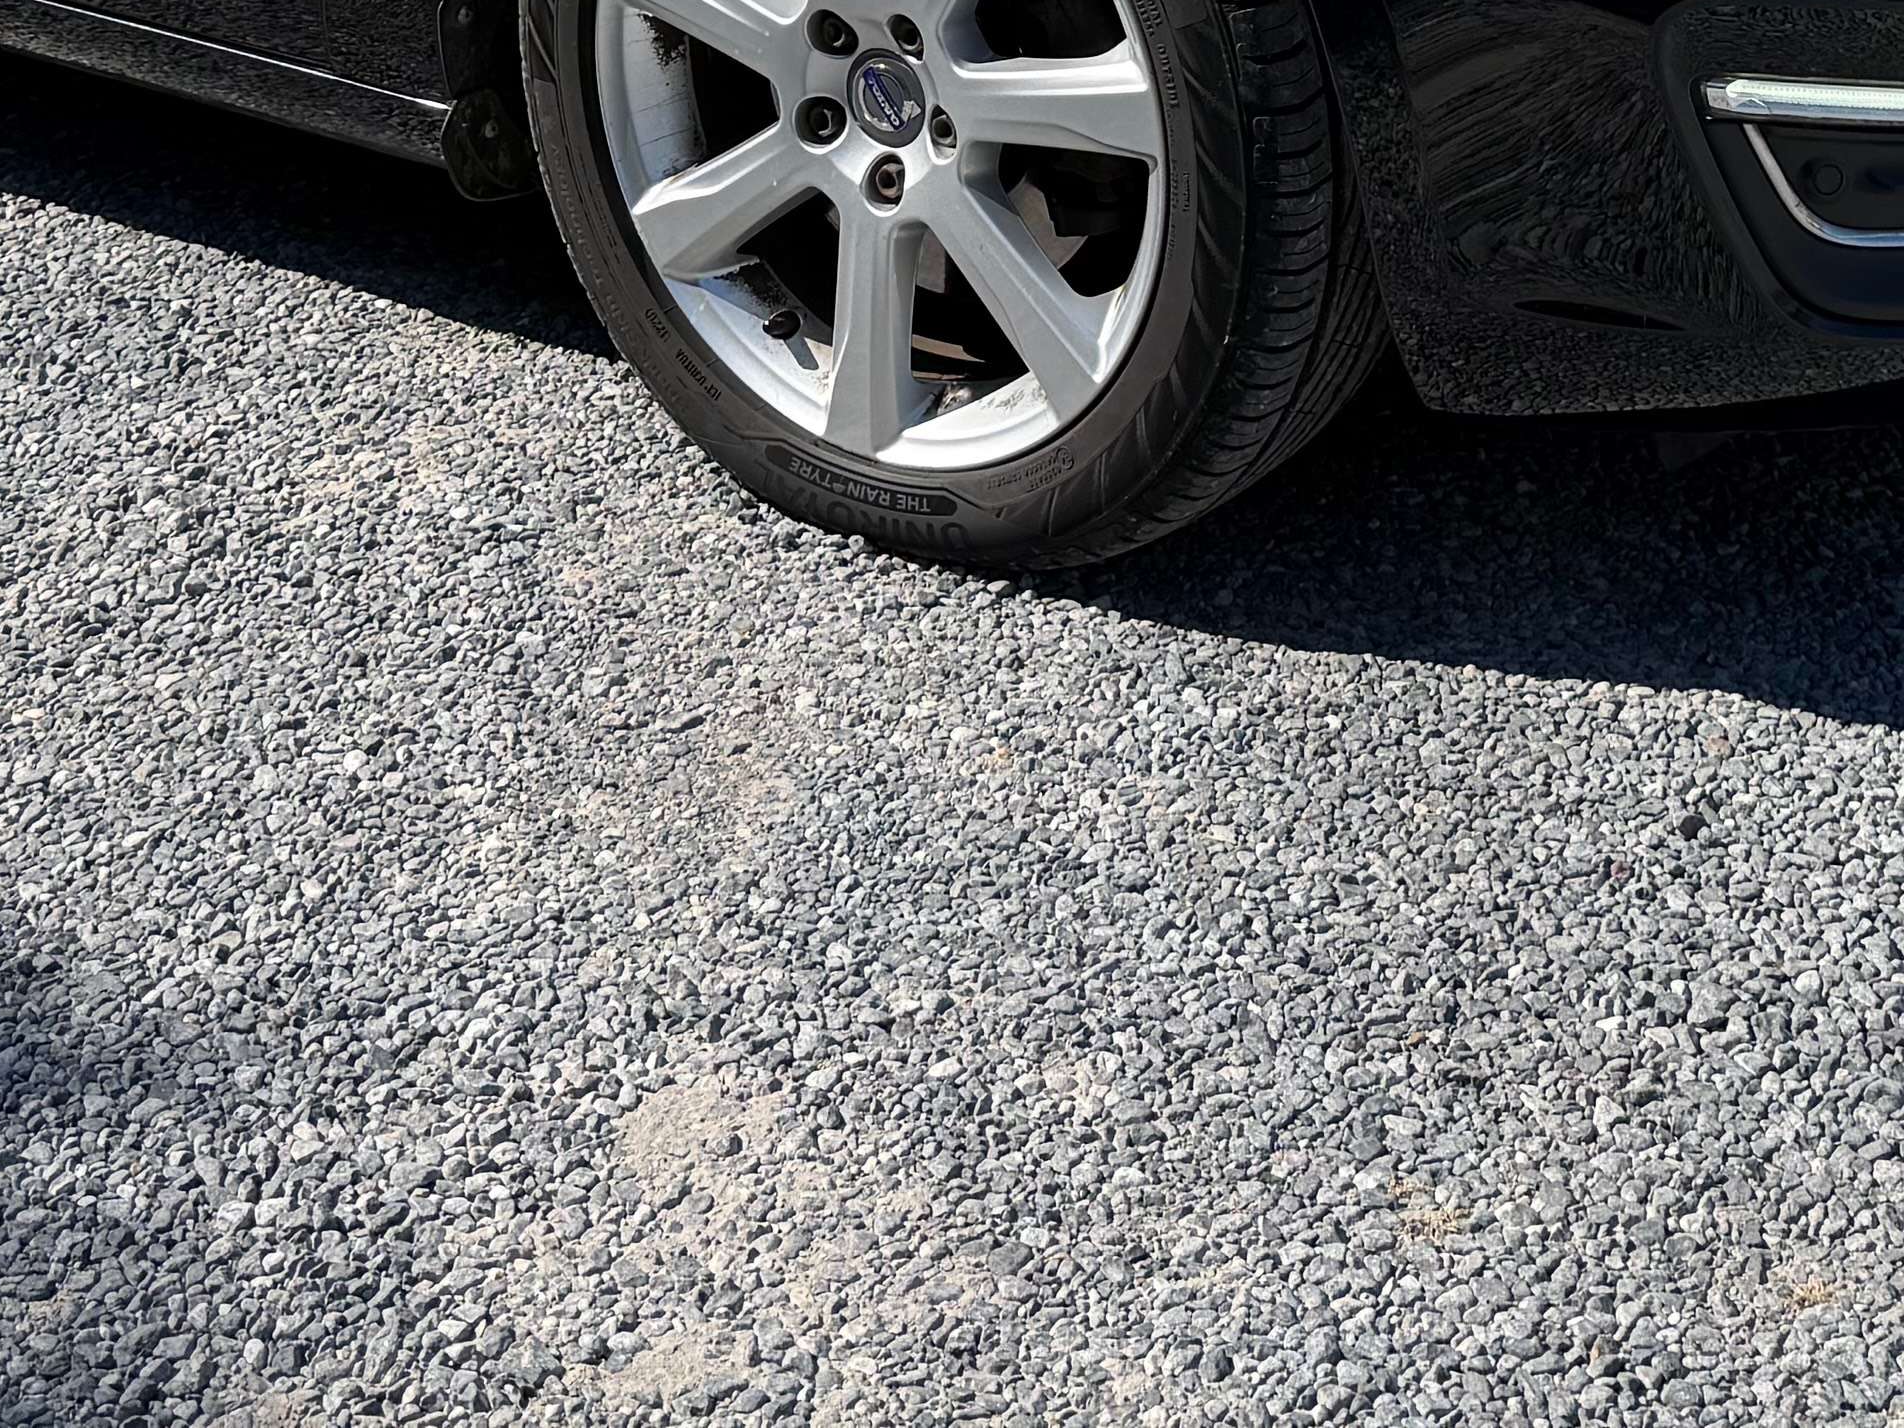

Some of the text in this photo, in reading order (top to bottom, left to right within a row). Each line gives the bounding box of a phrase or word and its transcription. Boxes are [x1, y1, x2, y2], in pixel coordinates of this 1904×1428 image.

[790, 455, 932, 513] THE RAIN TYRE
